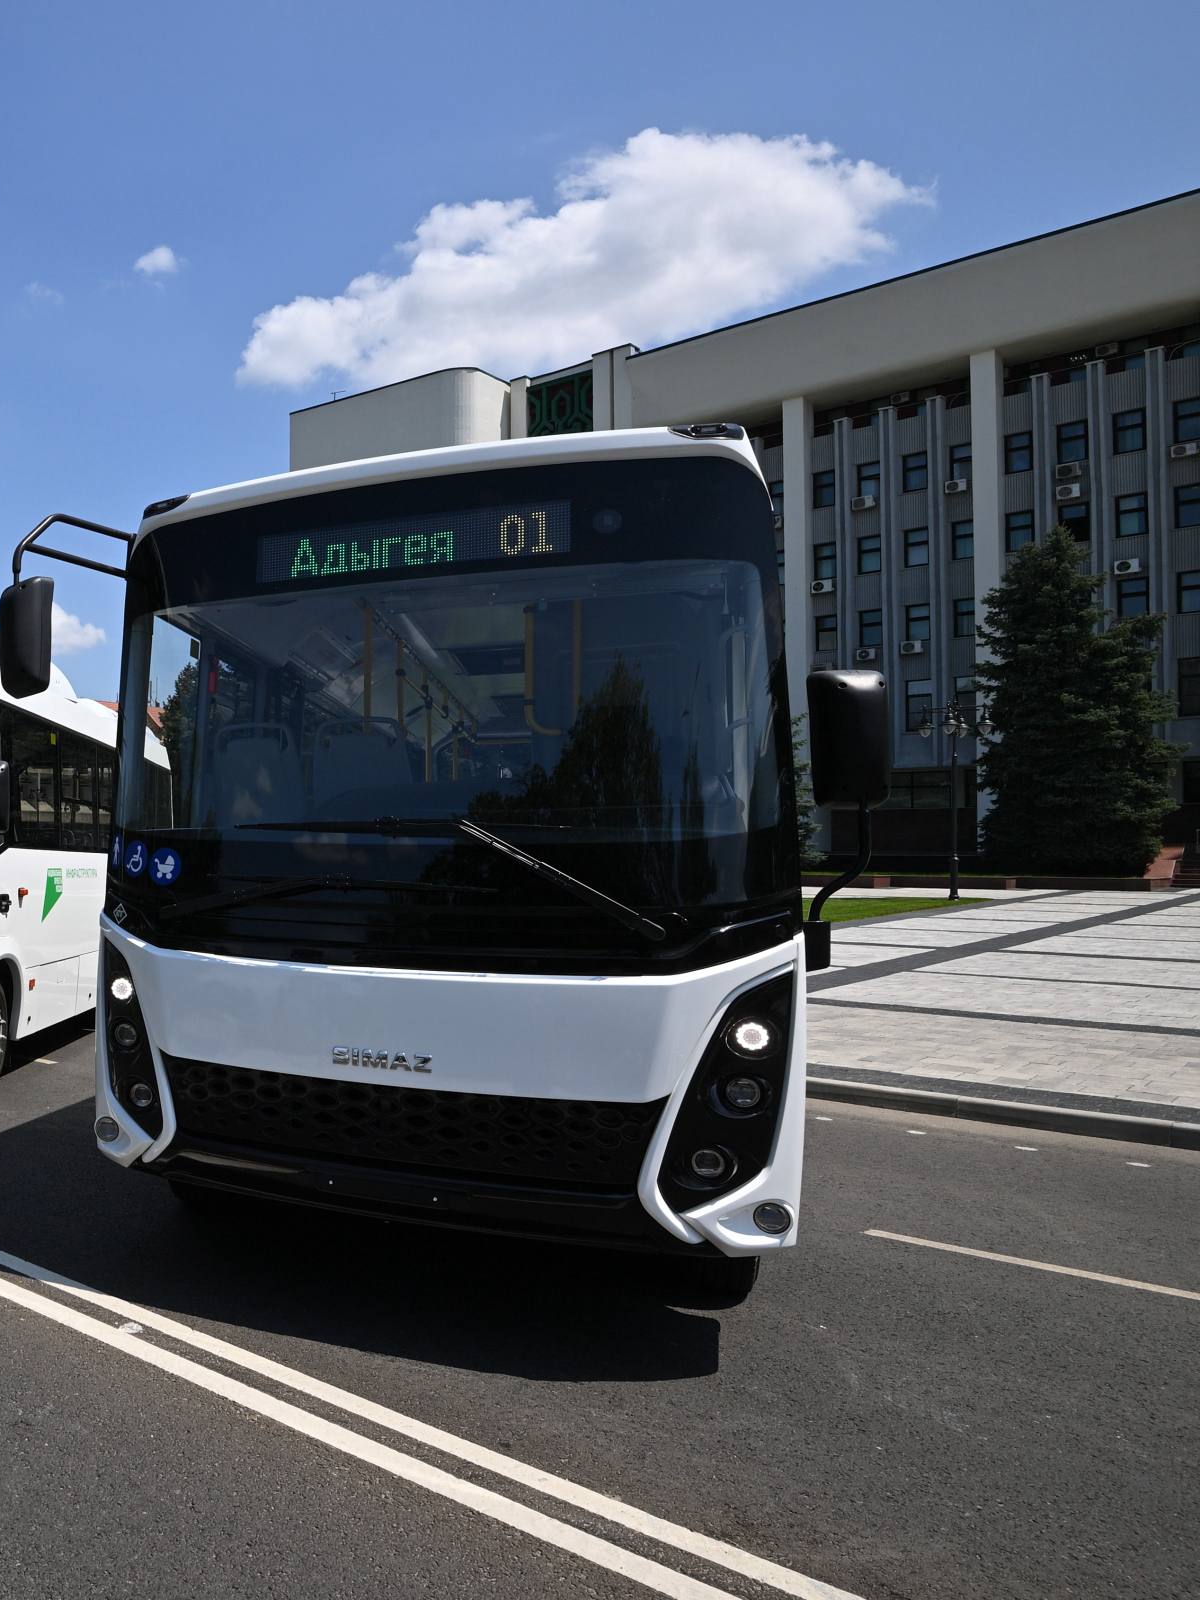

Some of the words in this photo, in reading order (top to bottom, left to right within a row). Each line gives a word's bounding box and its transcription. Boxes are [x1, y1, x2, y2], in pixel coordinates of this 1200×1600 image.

[290, 531, 454, 577] Адыгея
[500, 511, 553, 555] 01
[332, 1046, 433, 1074] SIMAZ
